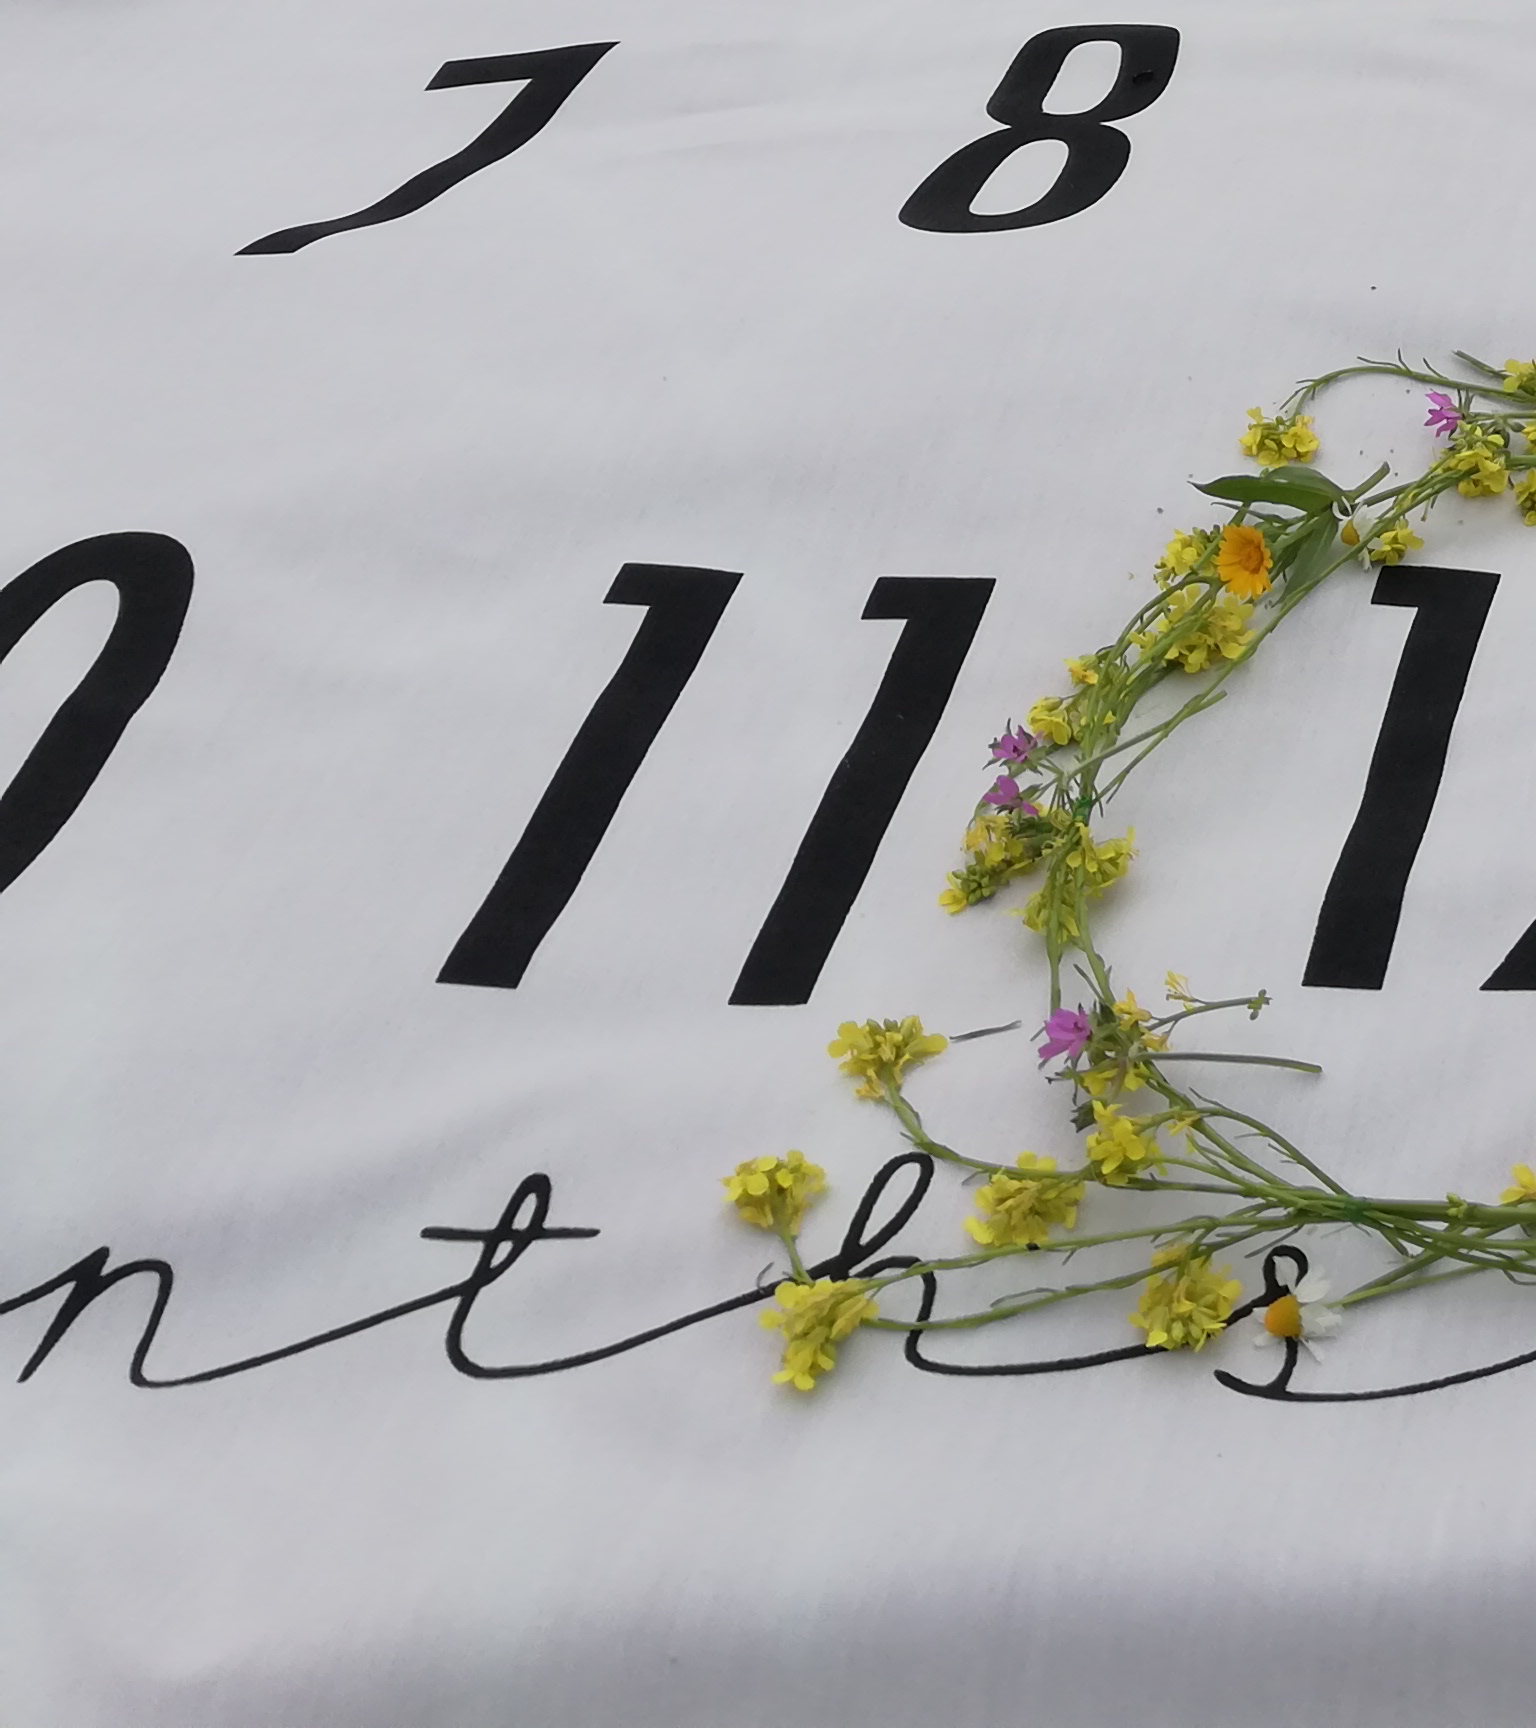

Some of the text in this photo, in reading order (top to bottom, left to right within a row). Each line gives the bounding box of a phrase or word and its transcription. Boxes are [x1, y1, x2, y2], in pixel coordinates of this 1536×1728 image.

[234, 40, 621, 256] 7
[897, 23, 1181, 235] 8
[435, 562, 998, 1006] 11
